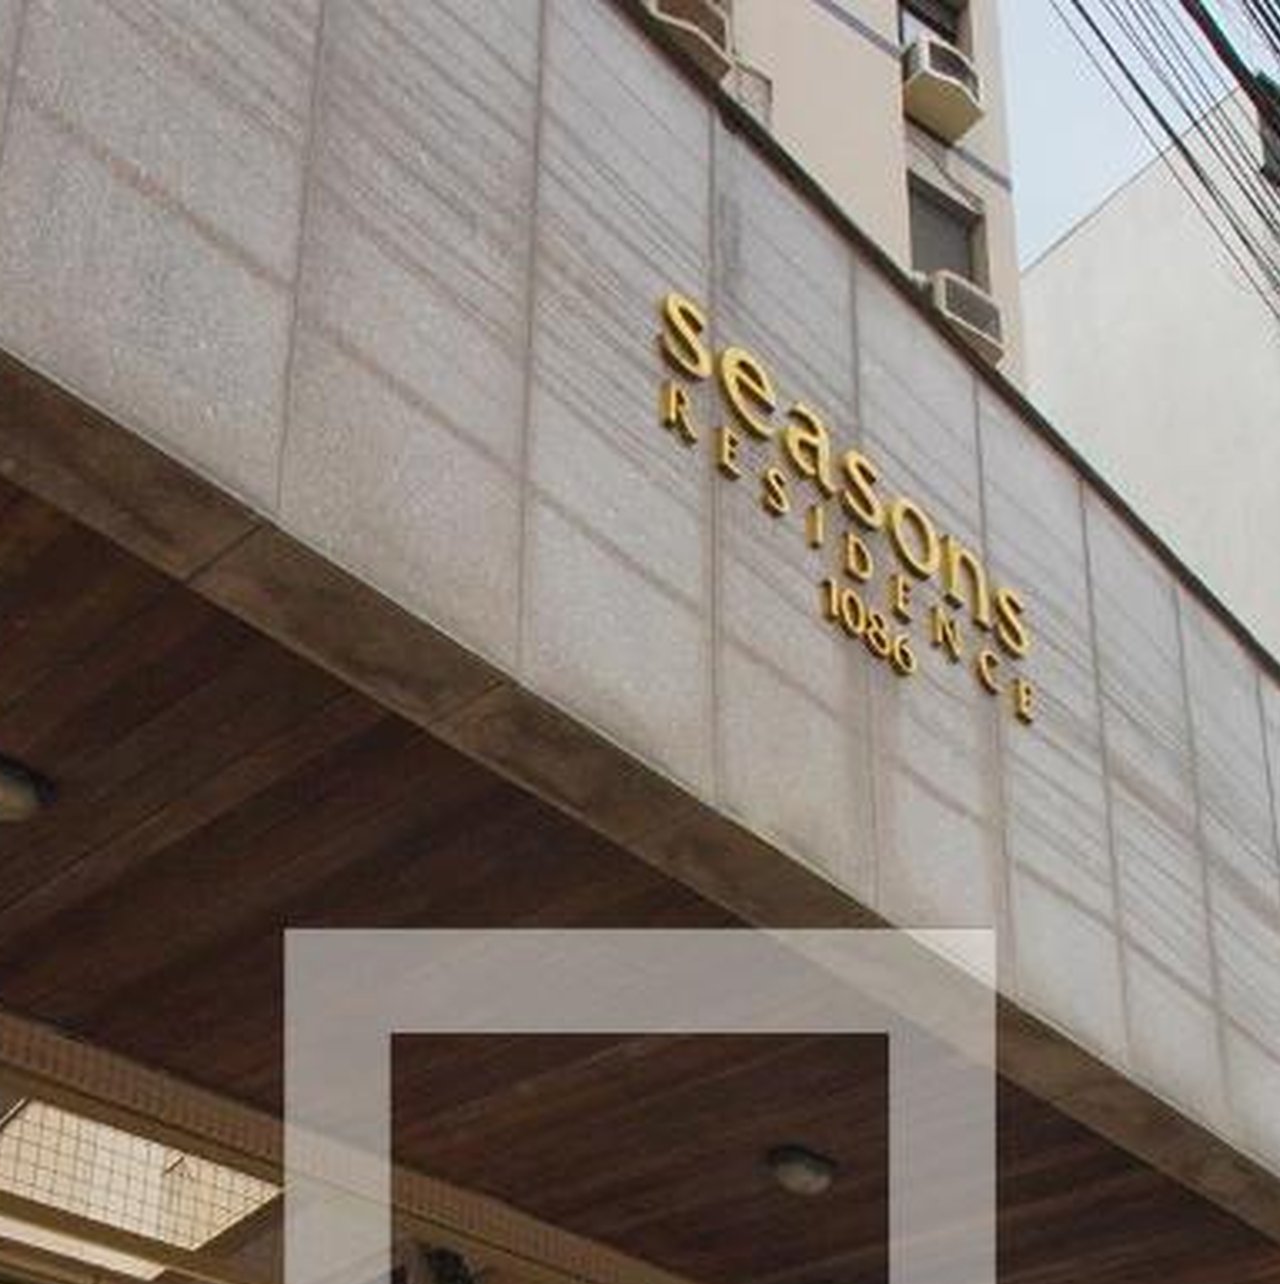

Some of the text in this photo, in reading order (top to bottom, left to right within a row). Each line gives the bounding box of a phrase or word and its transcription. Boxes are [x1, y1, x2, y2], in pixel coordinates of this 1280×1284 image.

[661, 292, 1030, 658] seasons
[663, 379, 1035, 725] RESIDENCE
[823, 577, 917, 676] 1086
